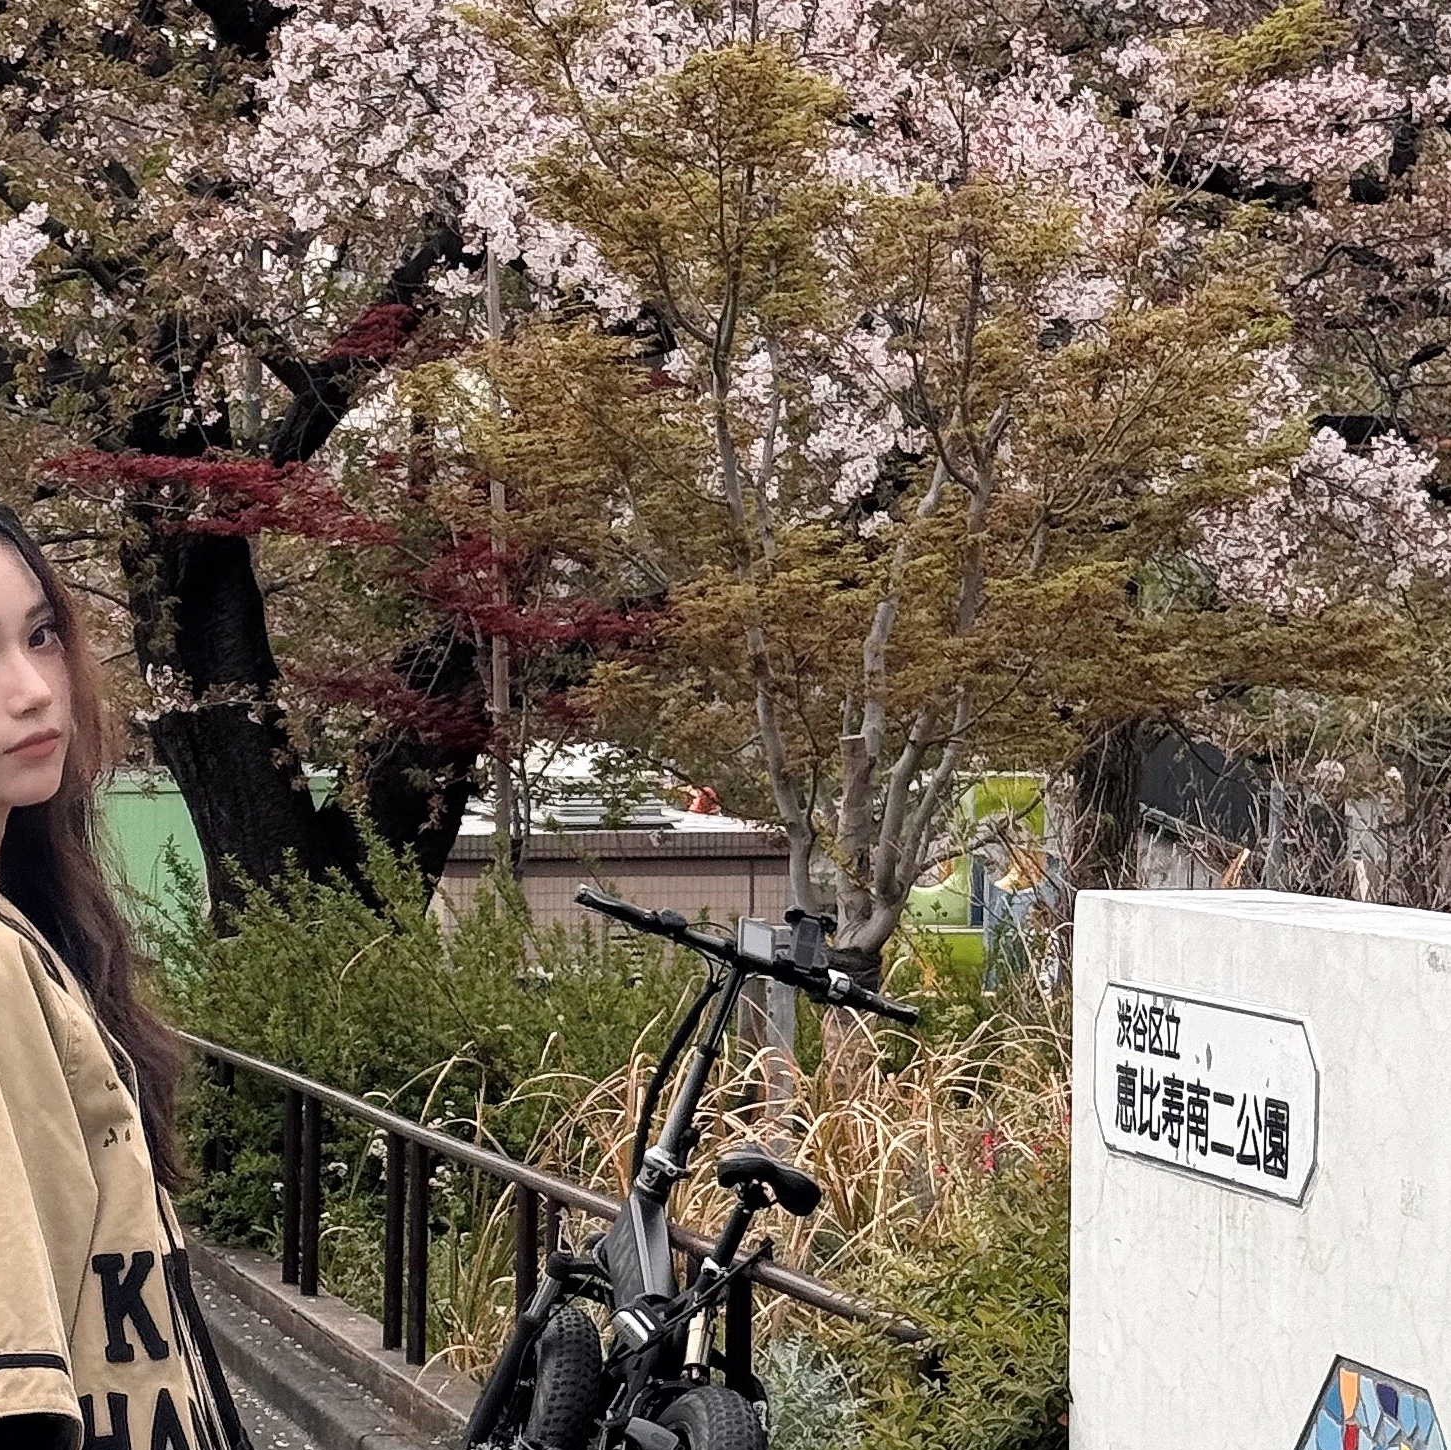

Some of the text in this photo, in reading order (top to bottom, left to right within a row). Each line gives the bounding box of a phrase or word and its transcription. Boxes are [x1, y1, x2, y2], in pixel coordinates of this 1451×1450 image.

[1117, 997, 1180, 1059] 渋谷区立
[1115, 1060, 1290, 1180] 恵比寿南二公園
